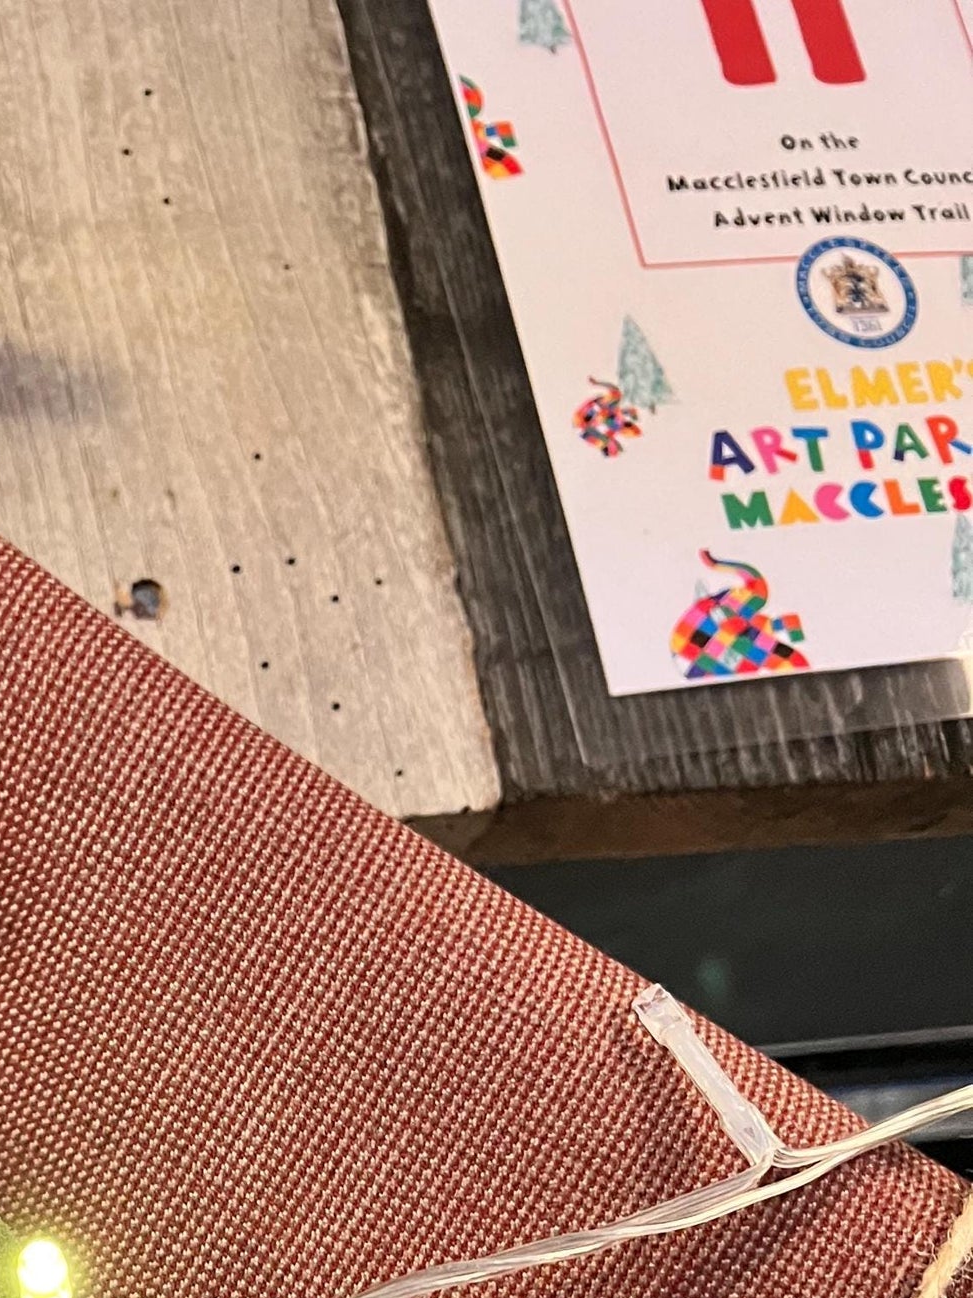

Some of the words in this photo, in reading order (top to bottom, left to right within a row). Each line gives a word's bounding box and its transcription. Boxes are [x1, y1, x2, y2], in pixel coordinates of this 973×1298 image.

[781, 134, 814, 151] On
[820, 131, 860, 150] the
[666, 167, 826, 192] Macclesfield
[832, 168, 898, 187] Town
[714, 206, 804, 227] Advent
[809, 202, 906, 223] Window
[912, 202, 971, 222] Trail
[784, 358, 973, 411] ELMER'
[708, 425, 830, 482] ART
[849, 414, 973, 471] PAR
[720, 475, 973, 531] MACCLES
